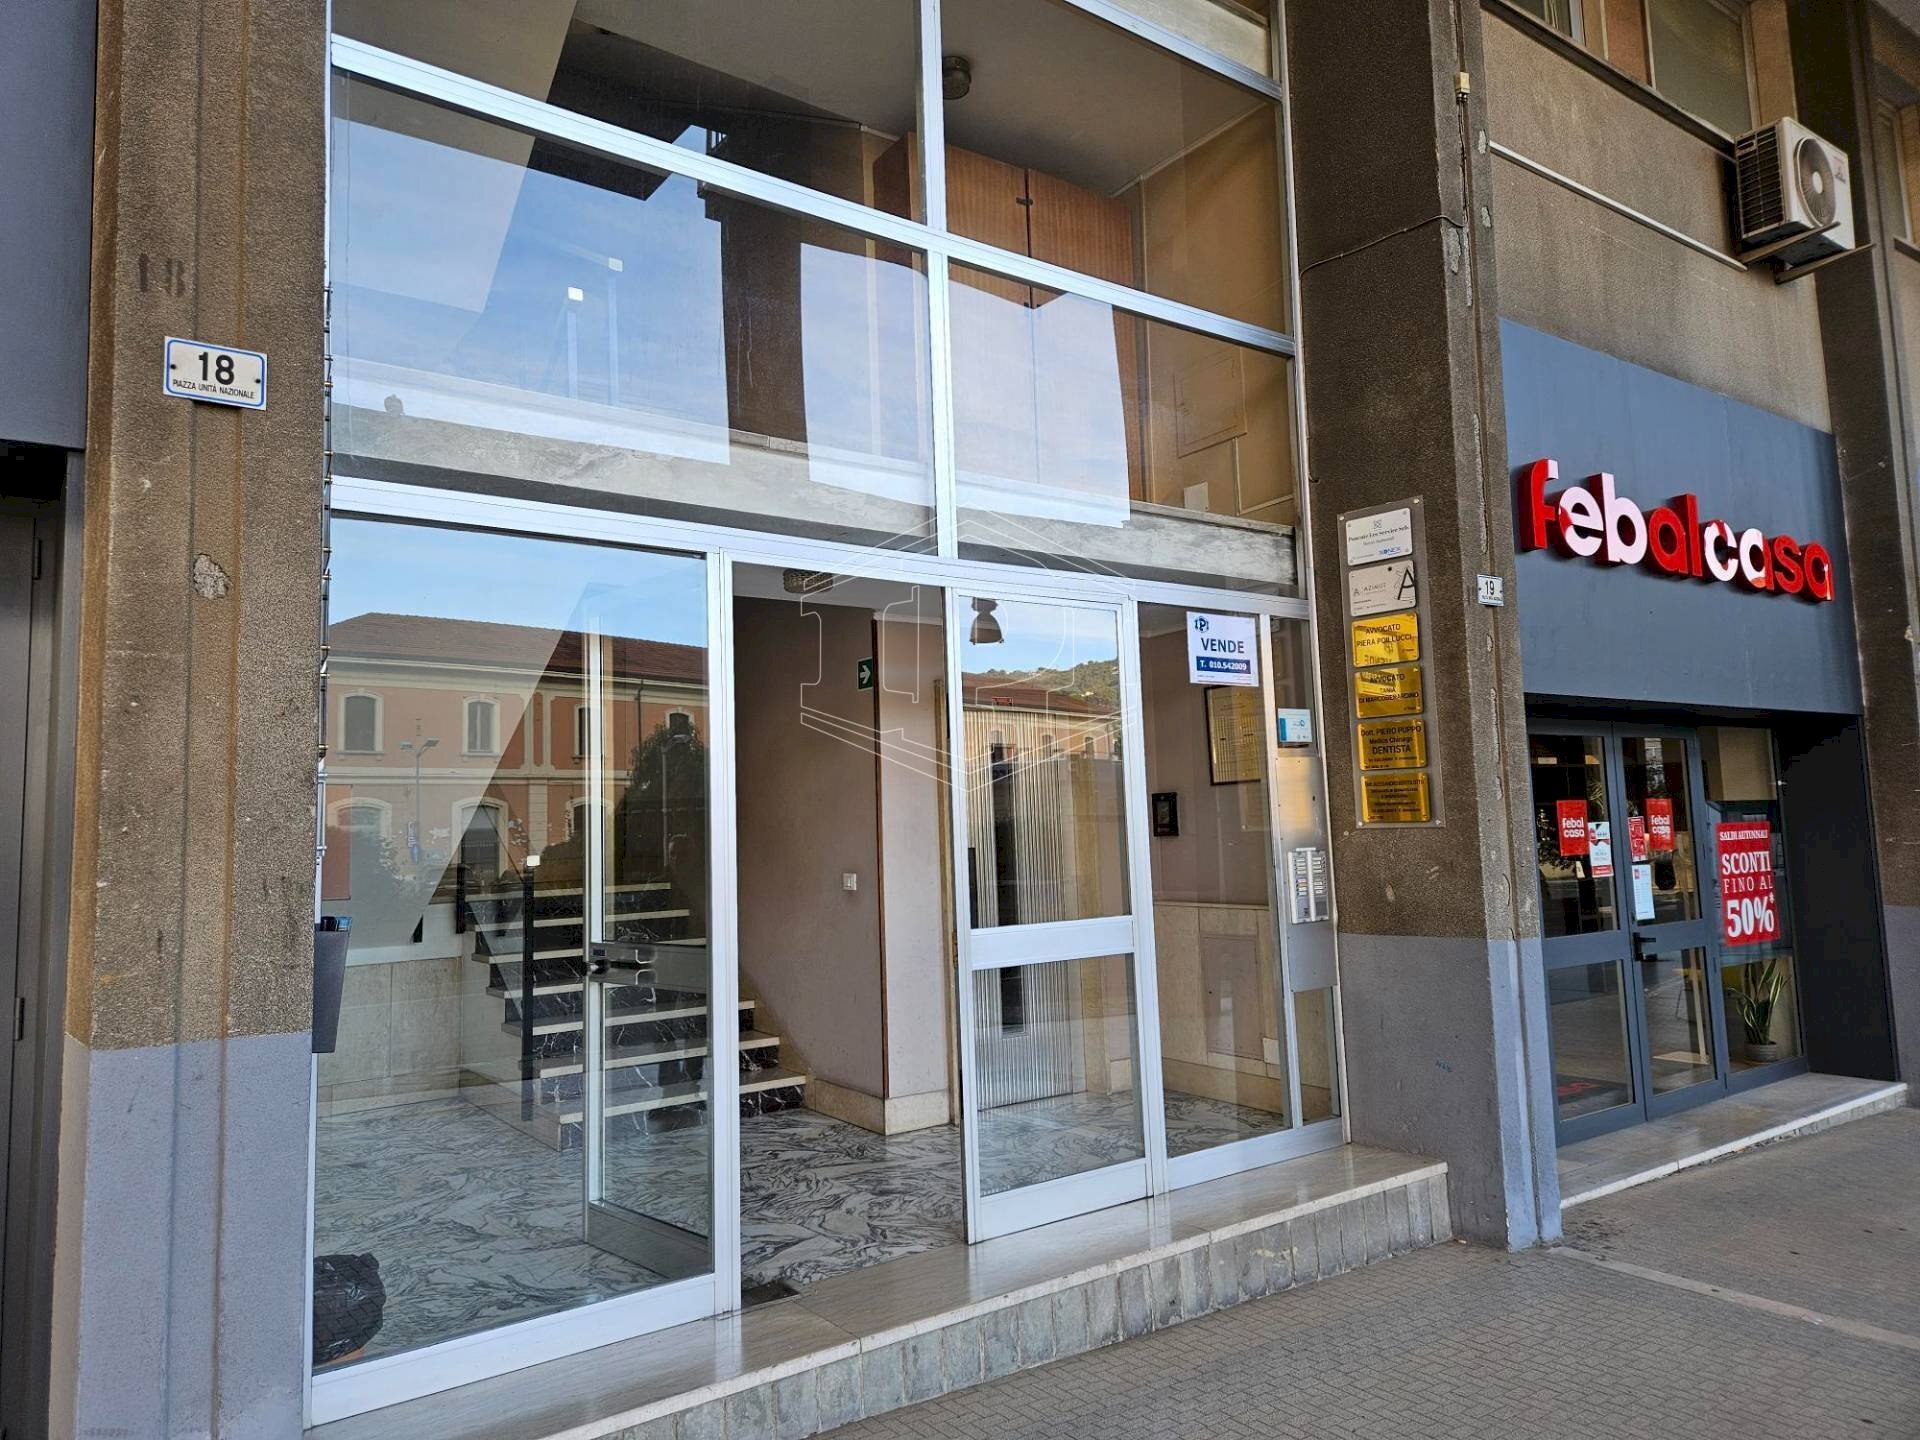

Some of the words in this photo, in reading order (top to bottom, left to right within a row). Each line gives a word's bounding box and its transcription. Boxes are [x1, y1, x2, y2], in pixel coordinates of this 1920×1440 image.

[199, 352, 234, 385] 18
[172, 379, 196, 390] PIAZZA
[199, 382, 217, 393] UNITÀ
[219, 387, 255, 399] NAZIONALE
[1485, 580, 1495, 595] 19
[1365, 624, 1400, 635] AVVOCATO
[1201, 637, 1245, 653] VENDE
[1356, 638, 1375, 647] PIERA
[1200, 660, 1207, 668] T.
[1369, 674, 1405, 684] AVVOCATO
[1376, 727, 1396, 736] PIERO
[1372, 745, 1411, 755] DENTISTA
[1562, 817, 1584, 828] febal
[1651, 815, 1670, 825] febal
[1563, 829, 1585, 838] casa
[1722, 851, 1770, 875] SCONTI
[1723, 876, 1754, 893] FINO
[1760, 875, 1773, 889] AL
